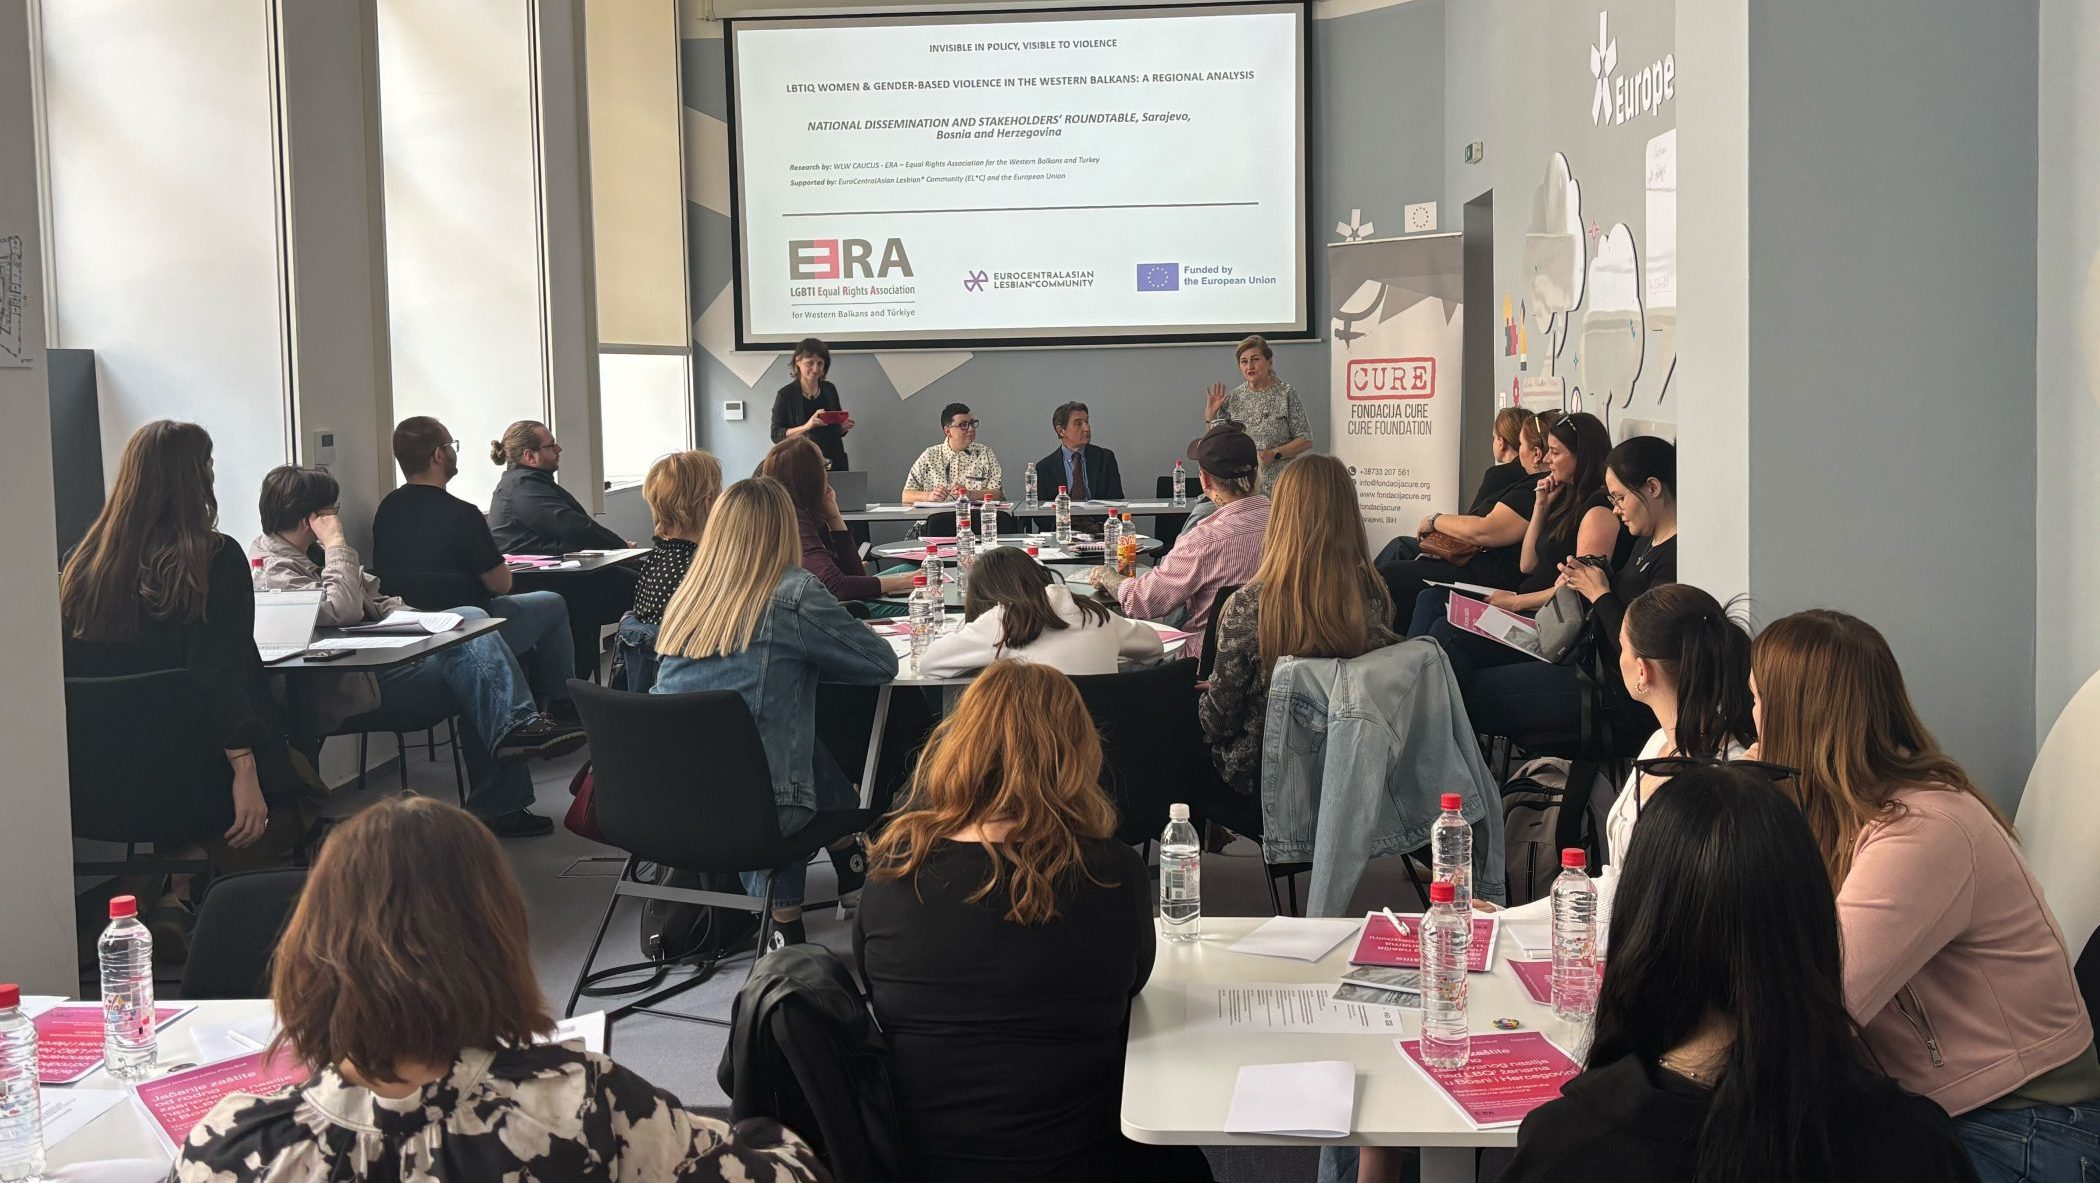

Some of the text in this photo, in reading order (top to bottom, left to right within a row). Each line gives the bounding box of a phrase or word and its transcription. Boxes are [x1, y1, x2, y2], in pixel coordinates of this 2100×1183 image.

[929, 44, 972, 52] INVISIBLE
[987, 42, 1020, 51] POLICY,
[1023, 41, 1056, 49] VISIBLE
[1058, 40, 1070, 49] TO
[1073, 39, 1117, 48] VIOLENCE
[786, 70, 1255, 93] LBTIQ WOMEN & GENDER-BASED VIOLENCE IN THE WESTERN BALKANS: A REGIONAL ANALYSIS
[1615, 53, 1675, 126] Europe
[807, 120, 863, 132] NATIONAL
[864, 118, 950, 131] DISSEMINATION
[951, 117, 976, 128] AND
[1064, 113, 1139, 125] ROUNDTABLE,
[1141, 111, 1191, 123] Sarajevo,
[936, 127, 1063, 141] Bosnia and Herzegovina
[821, 164, 832, 172] by:
[905, 161, 924, 169] Equal
[925, 160, 946, 169] Rights
[1037, 157, 1063, 165] Balkans
[1078, 156, 1100, 165] Turkey
[790, 179, 825, 187] Supported
[826, 178, 837, 186] by:
[838, 177, 895, 185] EuroCentralAsian
[926, 175, 963, 183] Community
[1013, 173, 1045, 181] European
[1046, 172, 1066, 180] Union
[993, 270, 1094, 280] EUROCENTRALASIAN
[1184, 265, 1233, 275] Funded by
[1184, 276, 1276, 286] the European Union
[790, 285, 915, 298] LGBTI Equal Rights Association
[792, 308, 916, 319] for Western Balkans and Türkiye
[1354, 366, 1427, 391] CURE
[1351, 403, 1429, 419] FONDACIJA CURE
[1348, 420, 1432, 435] CURE FOUNDATION
[1360, 468, 1383, 476] +38733
[1384, 468, 1396, 476] 207
